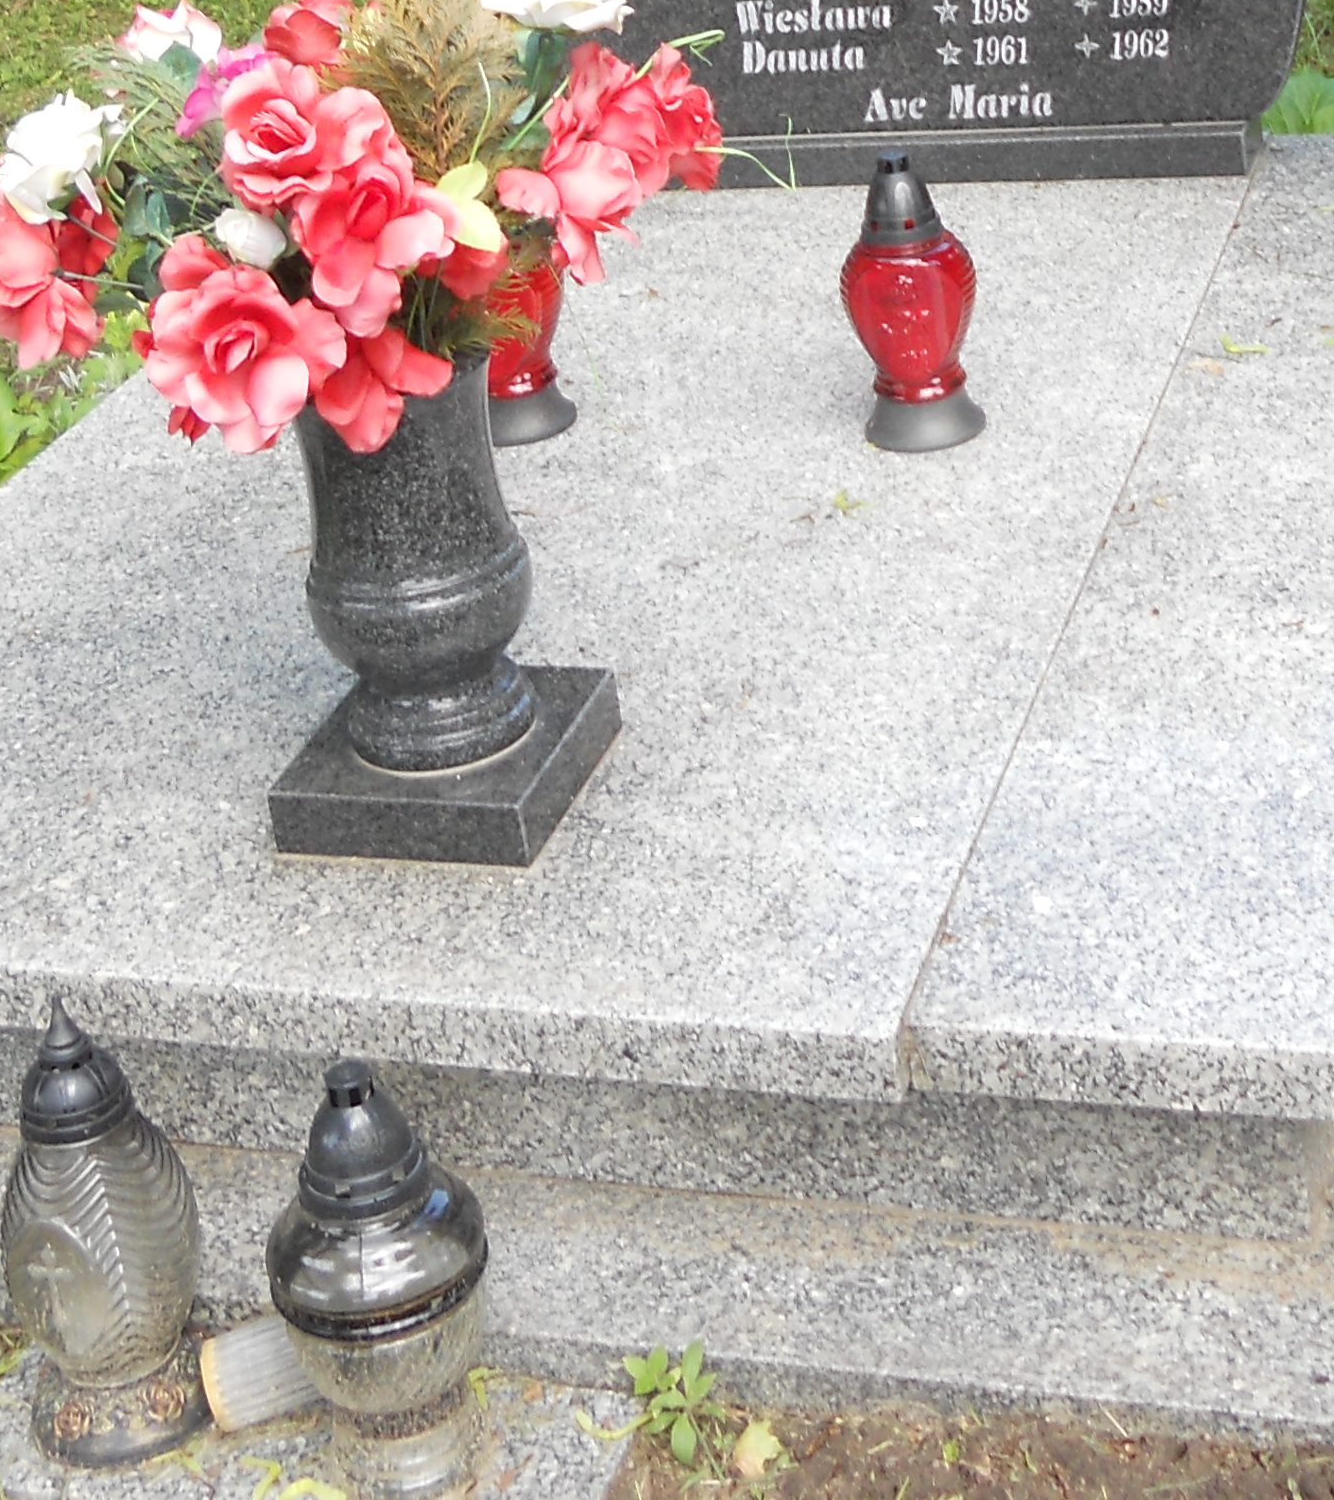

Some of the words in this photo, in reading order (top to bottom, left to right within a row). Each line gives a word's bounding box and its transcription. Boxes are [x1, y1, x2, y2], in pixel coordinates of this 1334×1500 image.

[742, 39, 865, 74] Danuta
[973, 34, 1029, 66] 1961
[1109, 28, 1169, 61] 1962
[864, 88, 927, 123] Ave
[948, 83, 1053, 120] Maria
